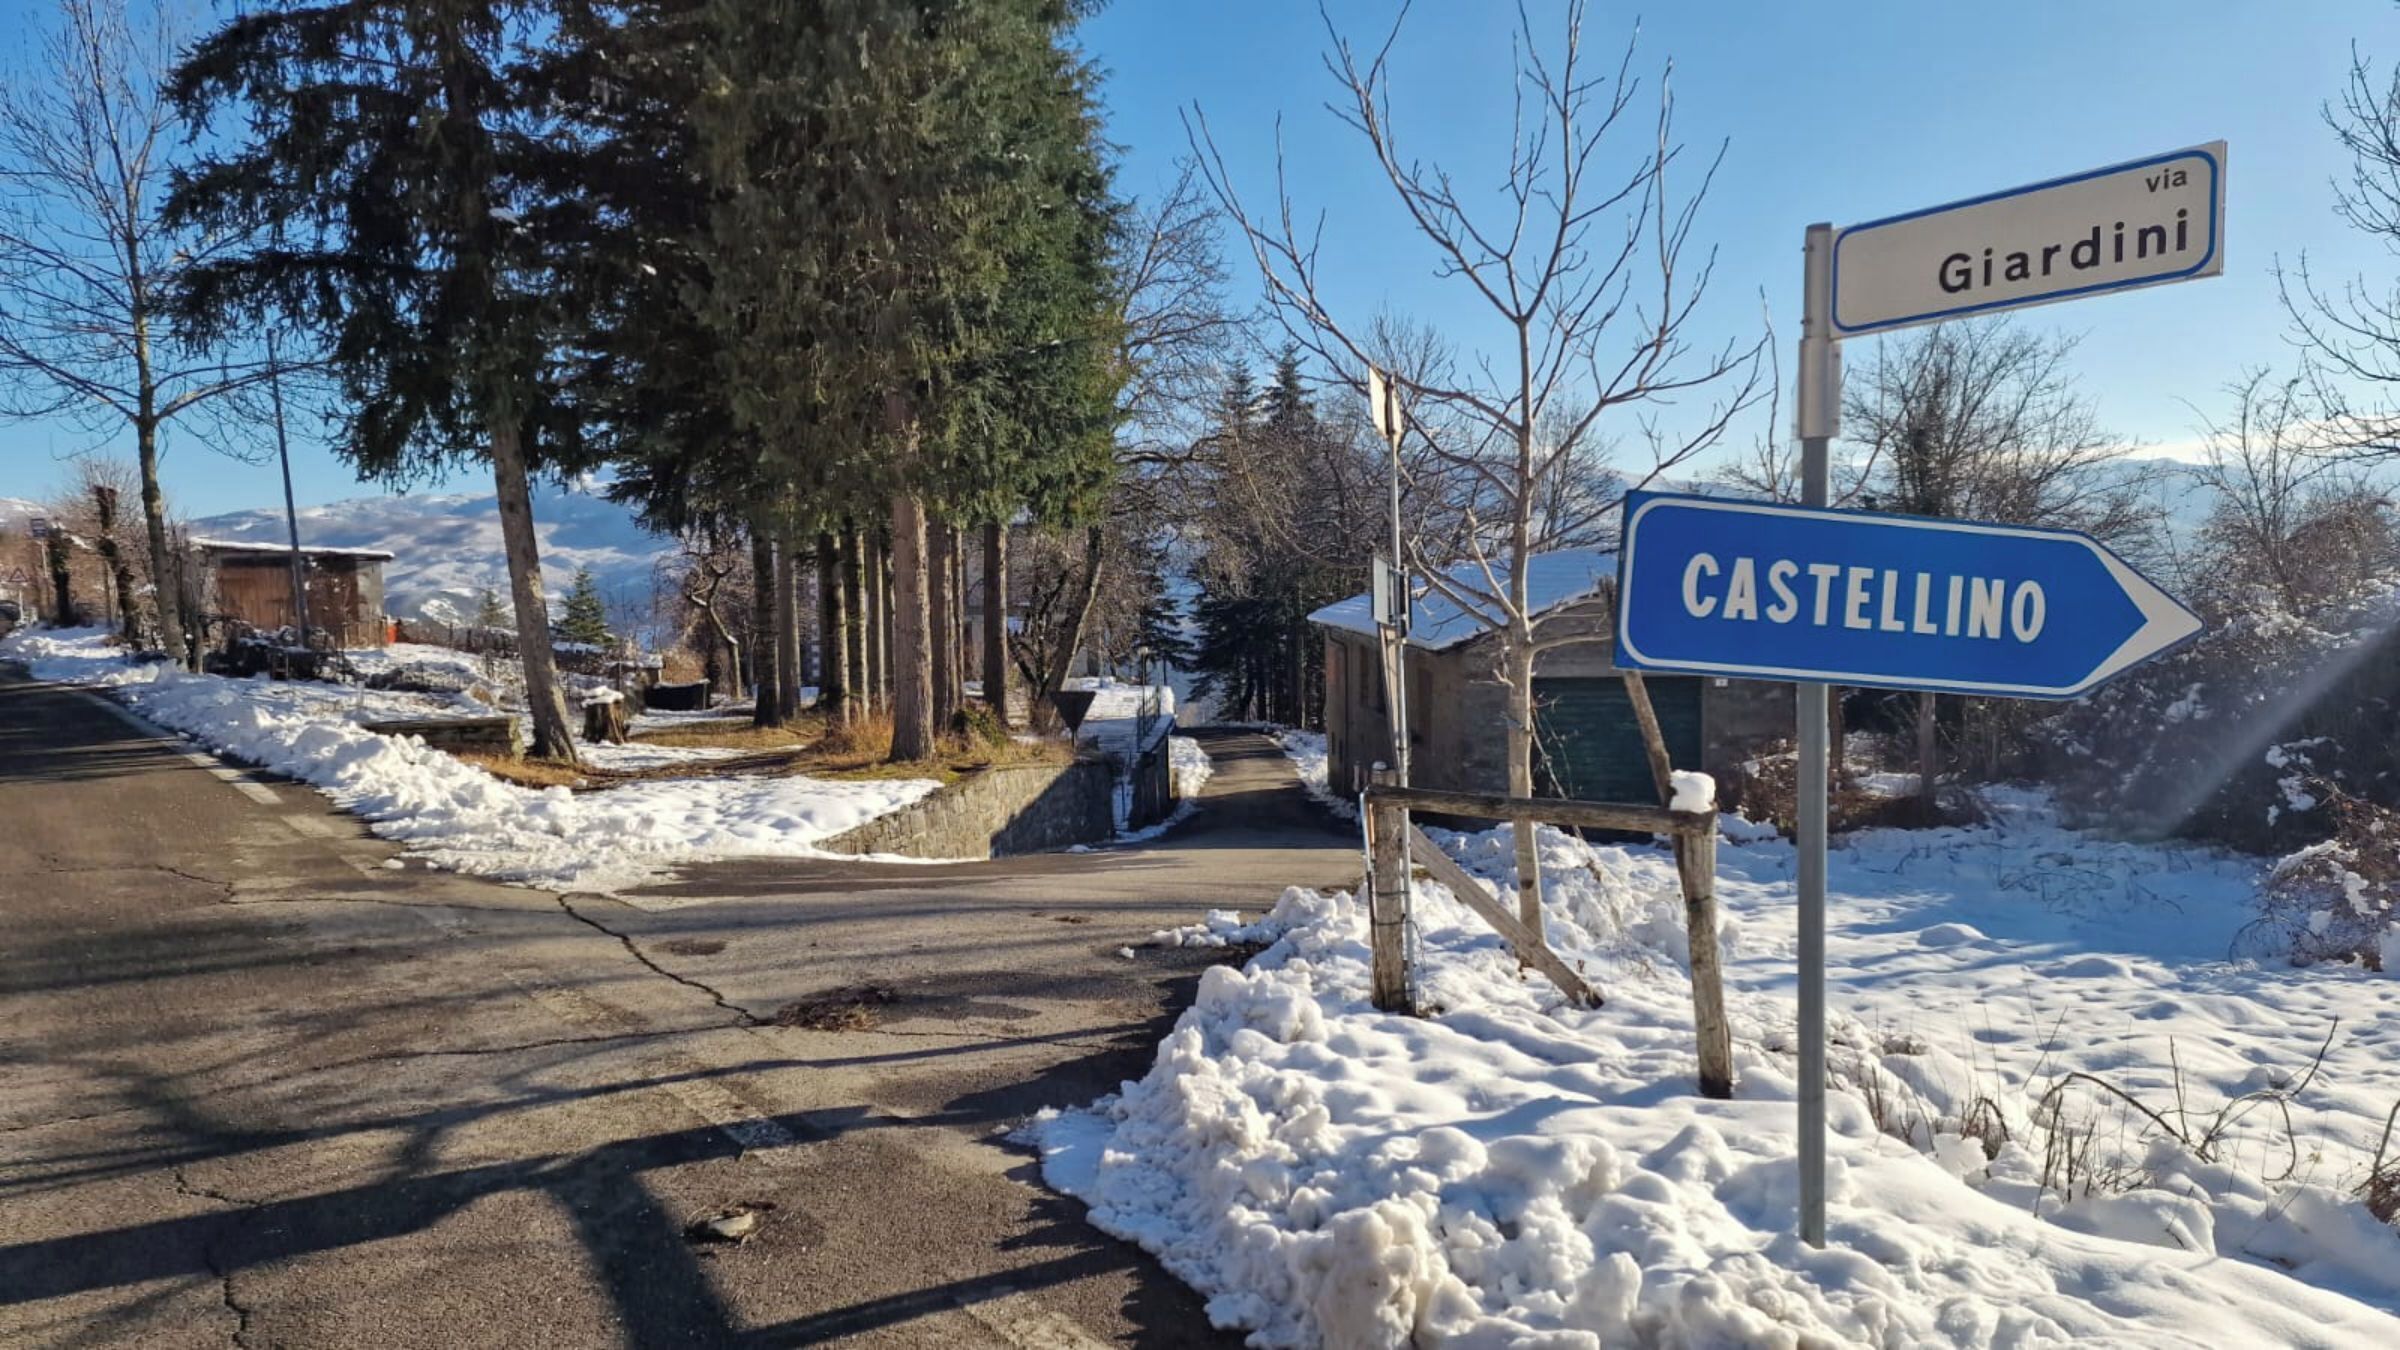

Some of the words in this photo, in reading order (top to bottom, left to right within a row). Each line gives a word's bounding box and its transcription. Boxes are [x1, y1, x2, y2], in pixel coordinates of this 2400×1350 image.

[2145, 168, 2188, 193] via
[1938, 208, 2188, 293] Giardini
[1682, 552, 2046, 643] CASTELLINO
